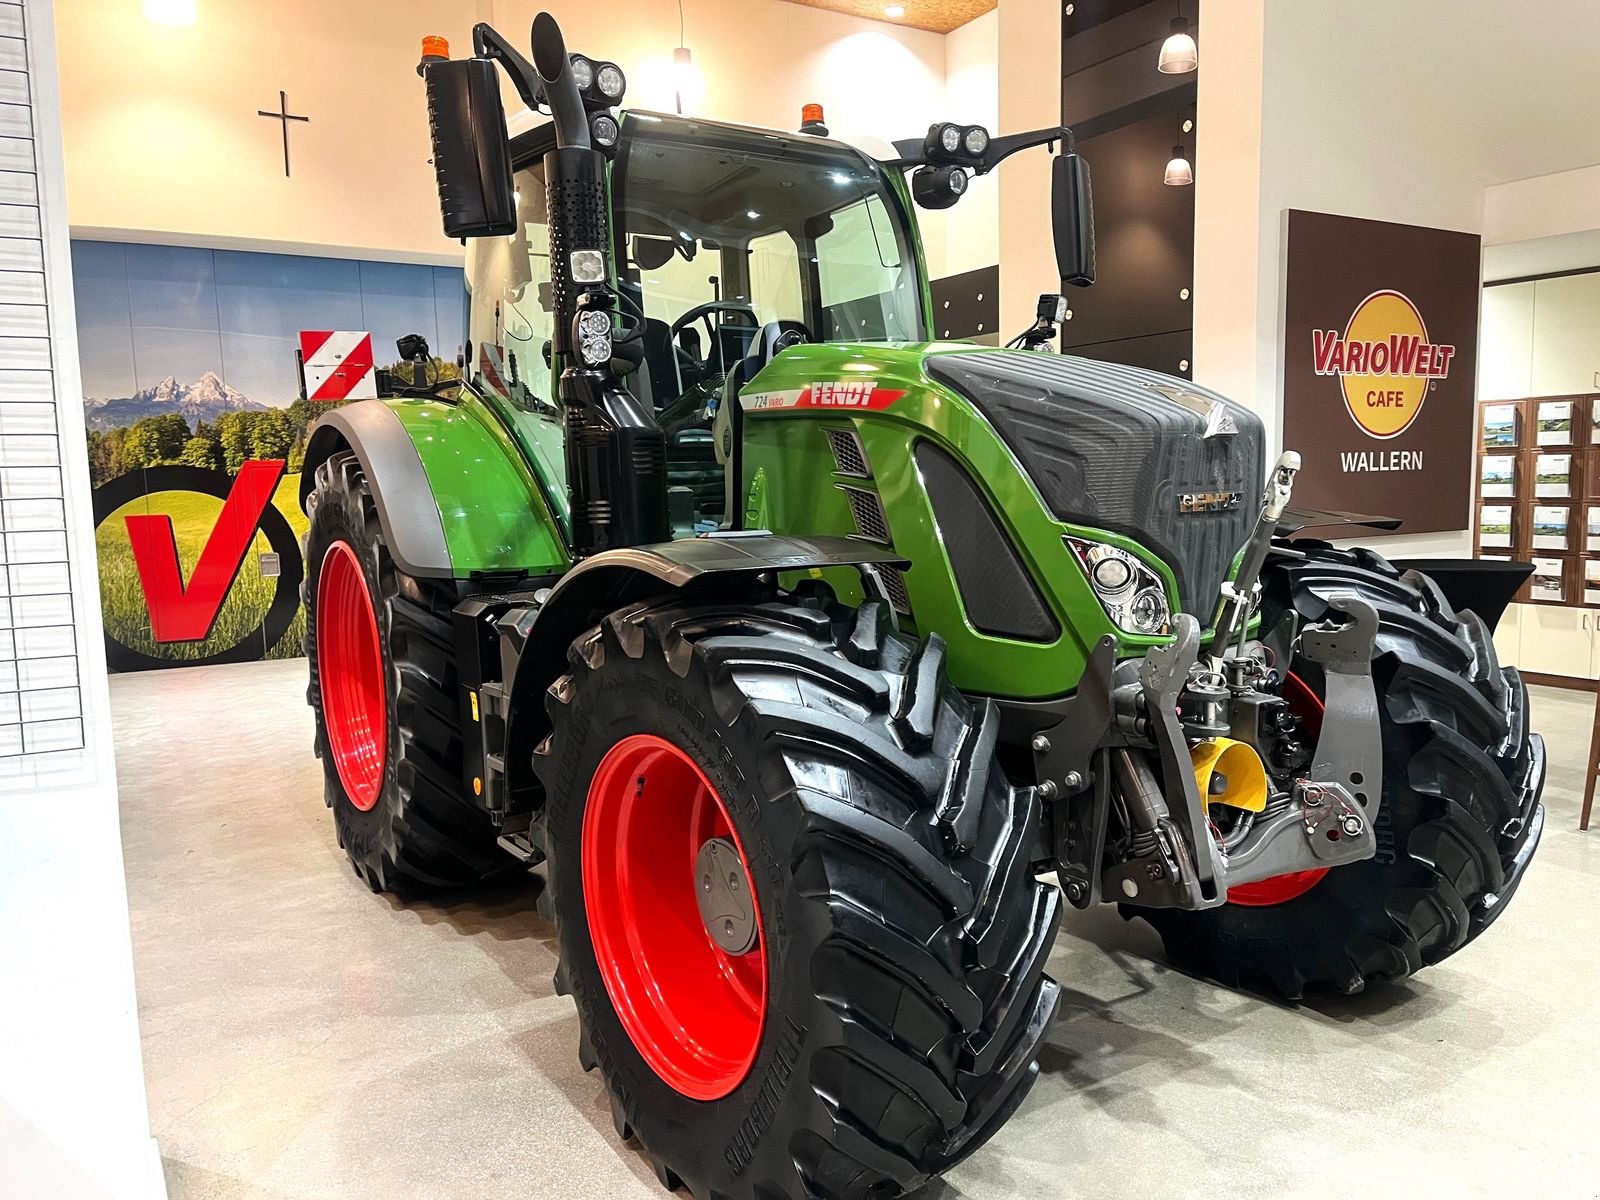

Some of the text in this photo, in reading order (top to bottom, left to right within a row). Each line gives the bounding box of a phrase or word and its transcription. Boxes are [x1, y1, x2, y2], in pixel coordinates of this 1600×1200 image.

[754, 395, 784, 408] 724 VARIO
[811, 382, 878, 406] FENDT
[1366, 390, 1404, 408] CAFE
[1340, 450, 1423, 472] WALLERN
